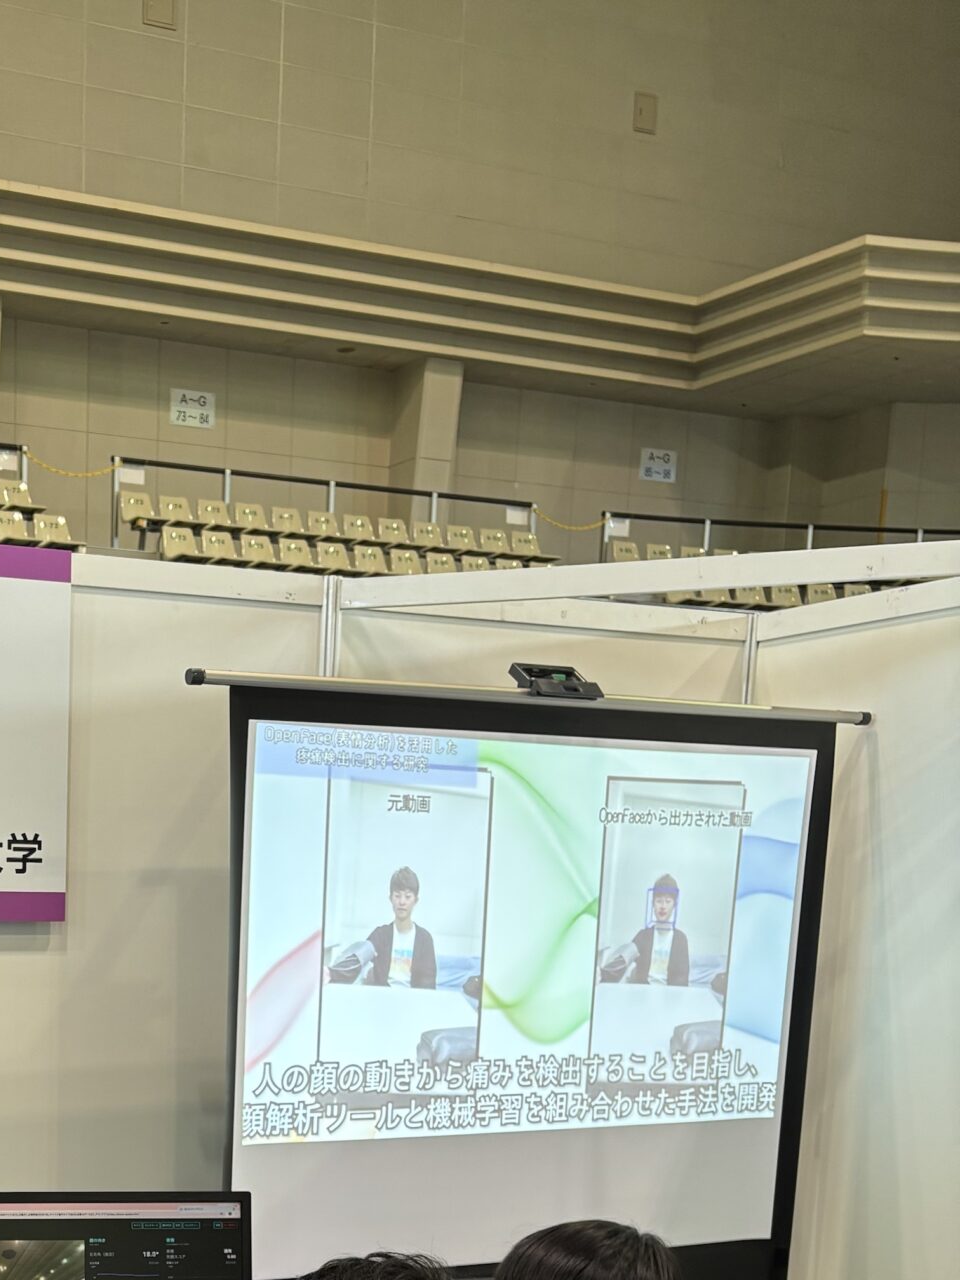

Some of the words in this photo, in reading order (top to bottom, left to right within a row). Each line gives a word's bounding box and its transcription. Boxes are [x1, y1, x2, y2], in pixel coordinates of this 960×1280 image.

[386, 793, 432, 814] 元動画
[598, 807, 754, 828] OpenFaceから出力された動画
[252, 1047, 759, 1096] 人の顔の動きから痛みを検出することを目指し、
